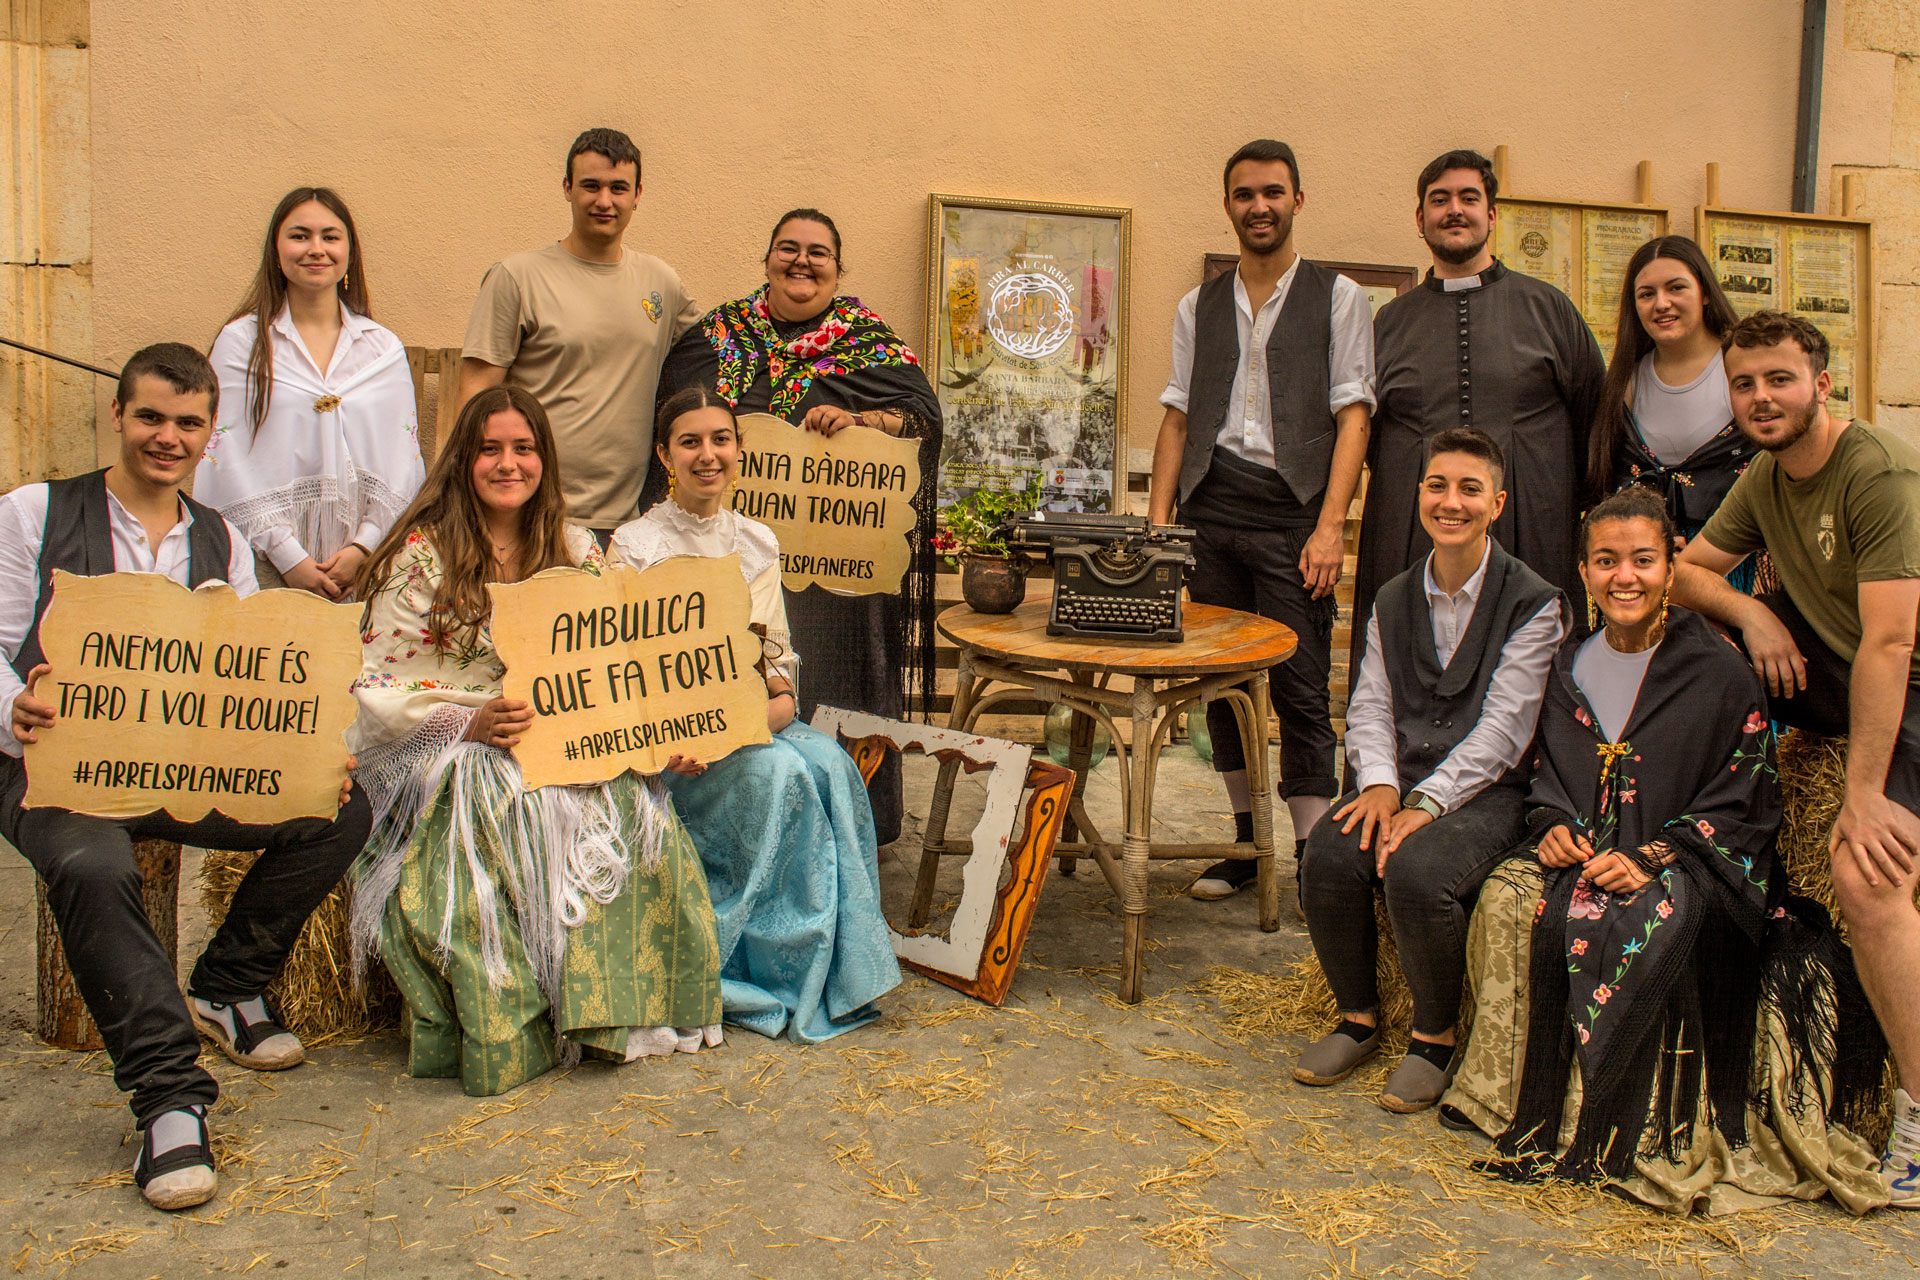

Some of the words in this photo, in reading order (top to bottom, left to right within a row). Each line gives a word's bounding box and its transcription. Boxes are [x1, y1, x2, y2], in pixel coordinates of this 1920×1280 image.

[986, 266, 1013, 289] FIRA
[1015, 260, 1031, 272] AL
[1032, 260, 1076, 294] CARRER
[1018, 360, 1028, 370] de
[1030, 360, 1048, 370] Sant
[737, 450, 792, 482] ANTA
[802, 452, 906, 492] BÀRBARA
[732, 488, 797, 520] QUAN
[807, 496, 886, 529] TRONA!
[780, 553, 874, 579] ELSPLANERES
[551, 591, 704, 655] AMBULICA
[80, 632, 203, 674] ANEMON
[214, 644, 271, 682] QUE
[278, 641, 310, 684] ÉS
[532, 668, 596, 717] QUE
[607, 660, 647, 704] FA
[659, 635, 738, 694] FORT!
[56, 682, 126, 722] TARD
[136, 688, 150, 723] I
[161, 690, 208, 728] VOL
[220, 694, 320, 734] PLOURE!
[564, 708, 727, 761] #ARRELSPLANERES
[72, 760, 282, 796] #ARRELSPLANERES
